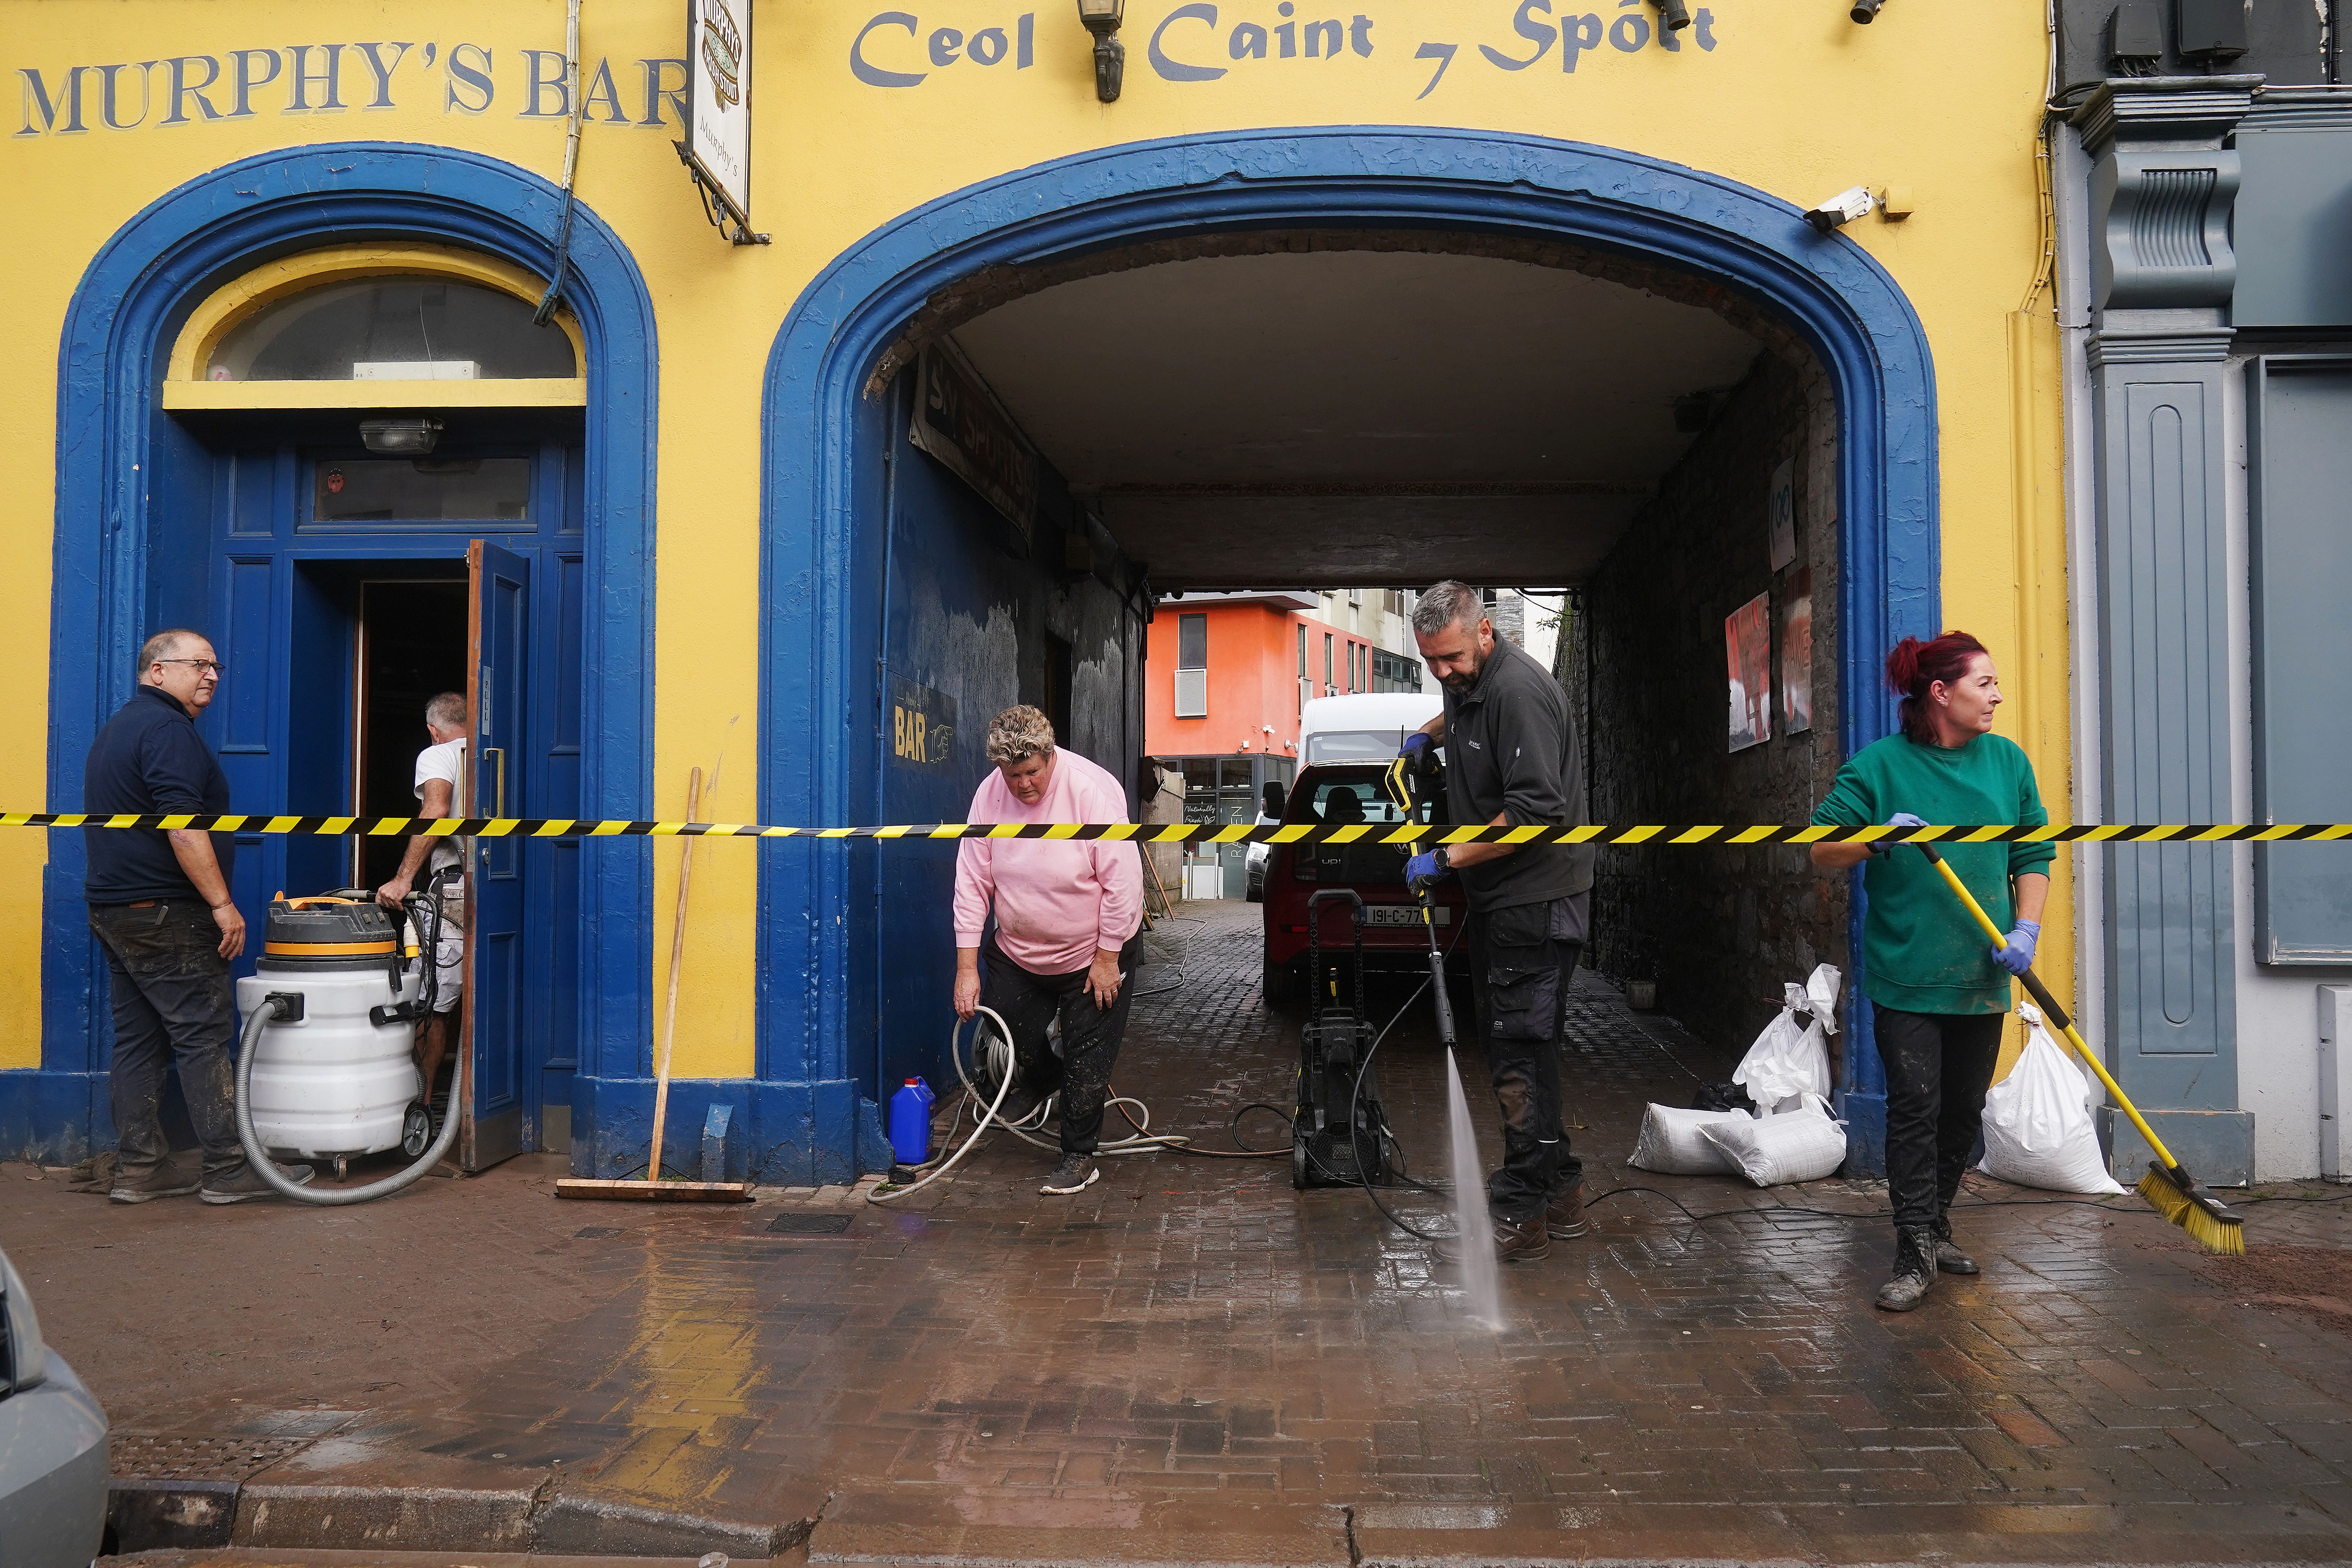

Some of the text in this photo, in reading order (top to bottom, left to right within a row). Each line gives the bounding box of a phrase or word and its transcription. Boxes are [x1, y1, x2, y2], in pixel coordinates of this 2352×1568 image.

[704, 44, 737, 100] IRISH STOUT
[849, 11, 1034, 87] Ceol
[1148, 1, 1374, 81] Caint
[13, 41, 687, 137] MURPHY'S BAR
[700, 115, 738, 177] Murphy's
[895, 705, 926, 764] BAR
[1184, 804, 1216, 814] Naturally
